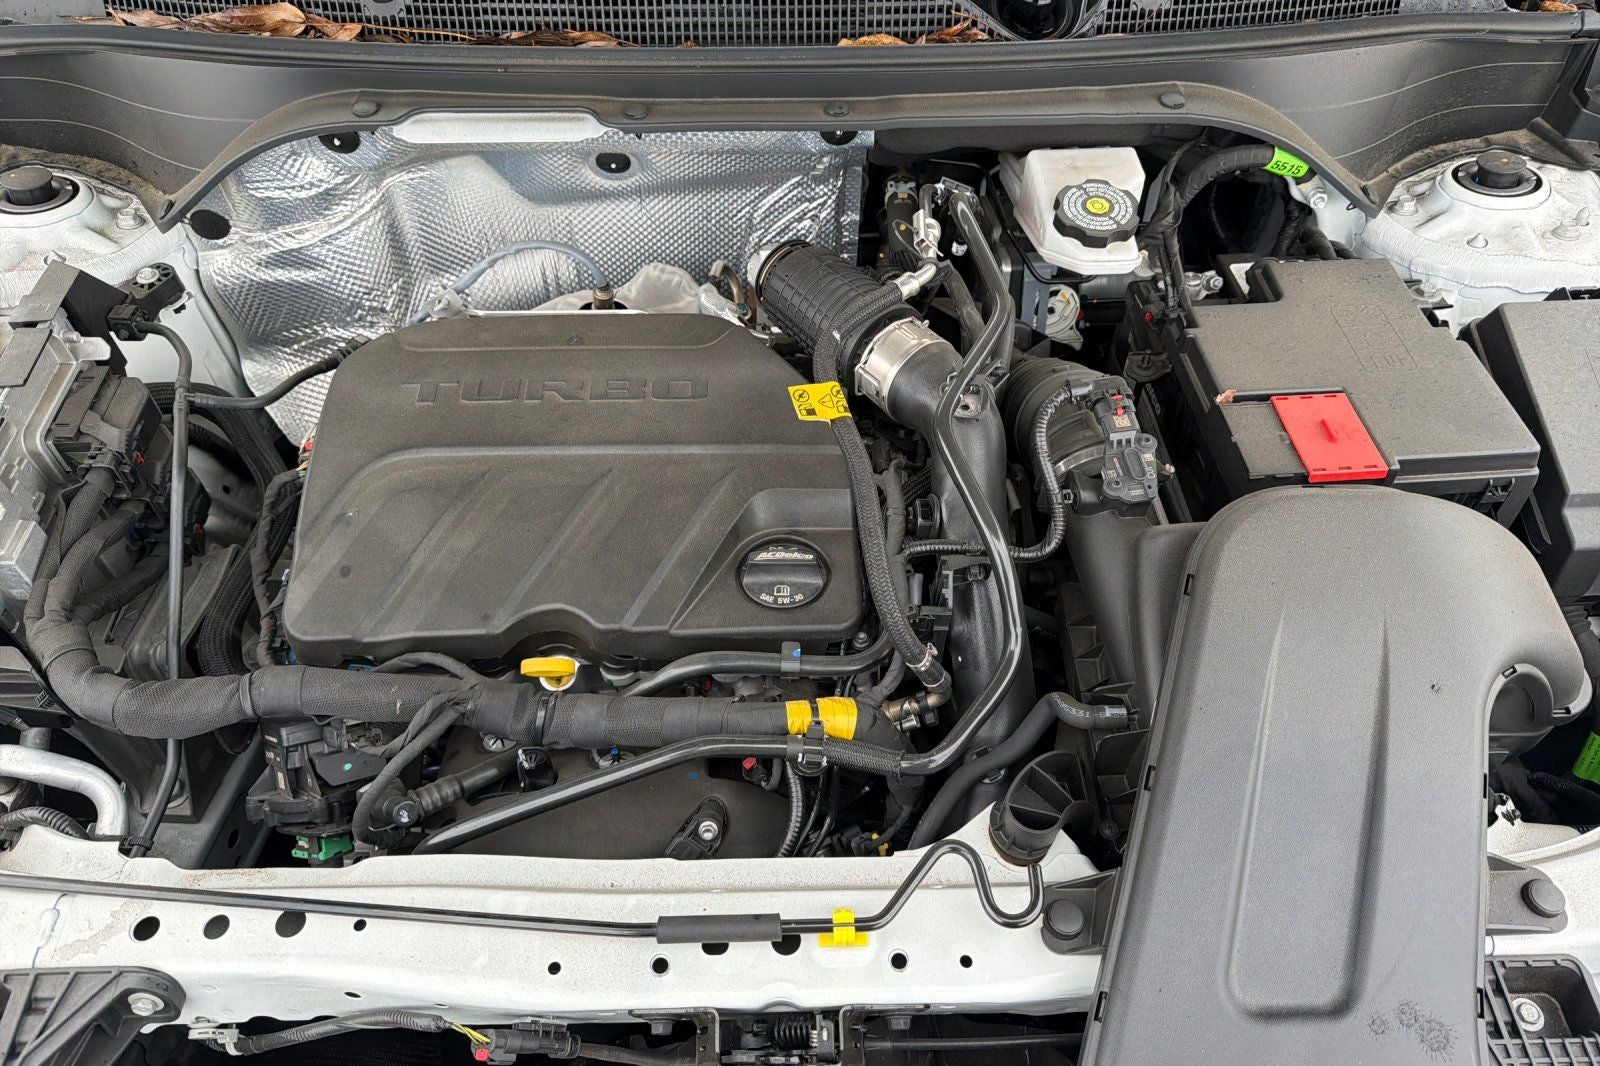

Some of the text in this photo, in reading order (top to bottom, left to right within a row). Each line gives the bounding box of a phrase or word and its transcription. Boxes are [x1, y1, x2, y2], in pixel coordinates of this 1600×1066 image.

[1271, 160, 1303, 175] 5515
[401, 379, 709, 405] TURBO
[754, 551, 814, 561] ACDelco
[760, 593, 804, 604] SAE 5W-30
